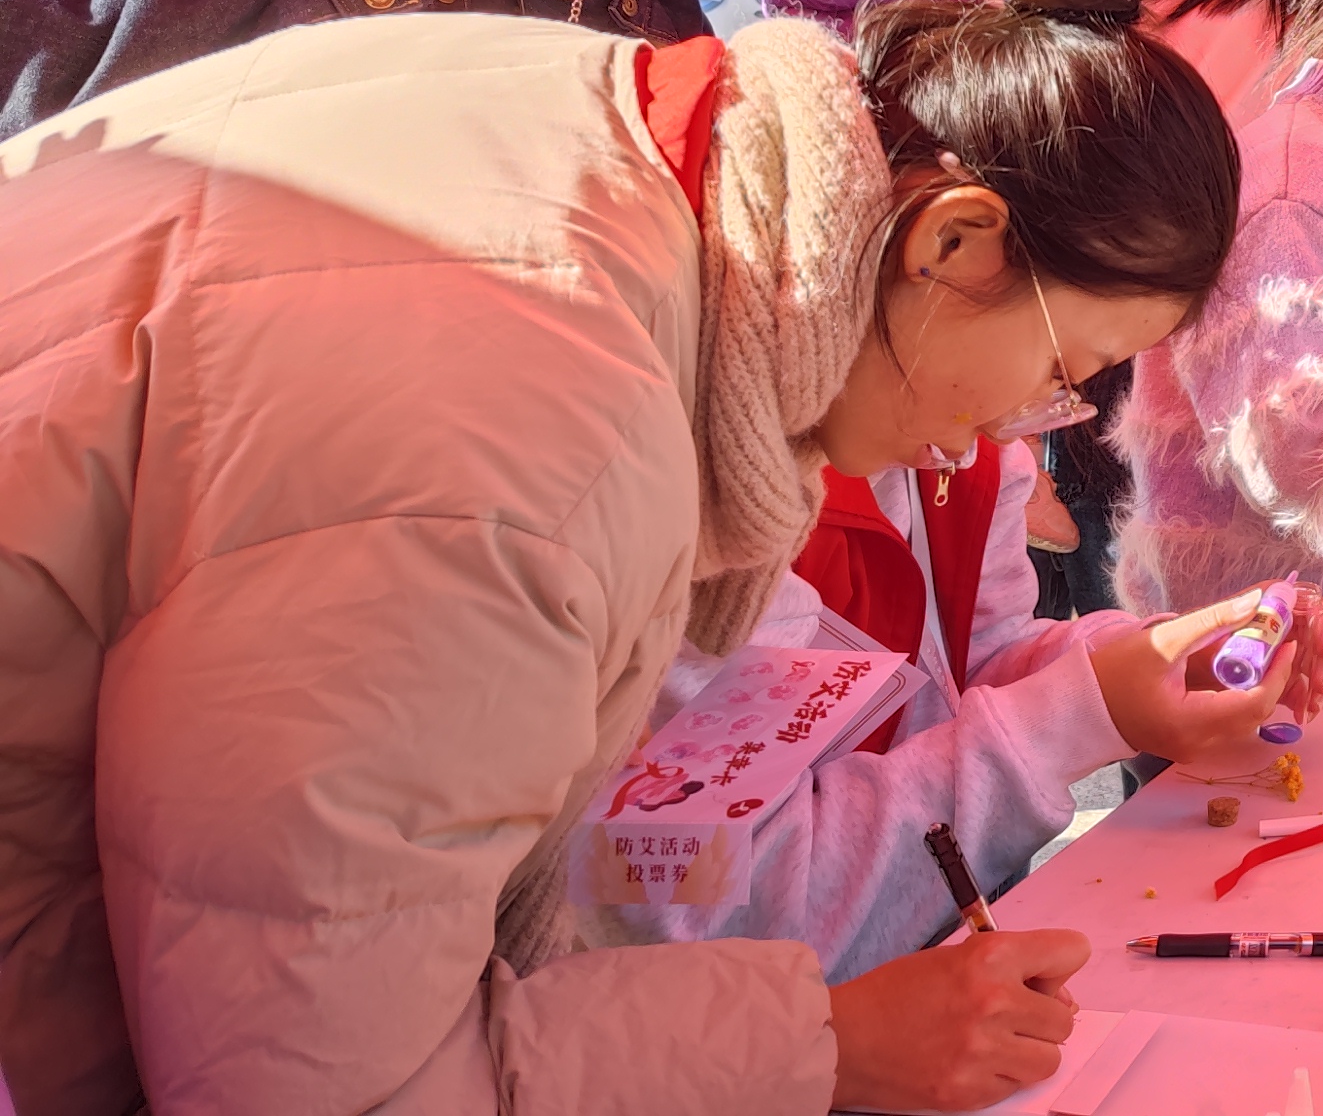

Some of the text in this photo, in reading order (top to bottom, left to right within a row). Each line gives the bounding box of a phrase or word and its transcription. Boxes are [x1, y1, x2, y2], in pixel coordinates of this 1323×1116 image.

[776, 660, 872, 744] 防艾活动
[710, 741, 767, 787] 集章卡
[615, 836, 700, 857] 防艾活动
[626, 863, 689, 884] 投票券
